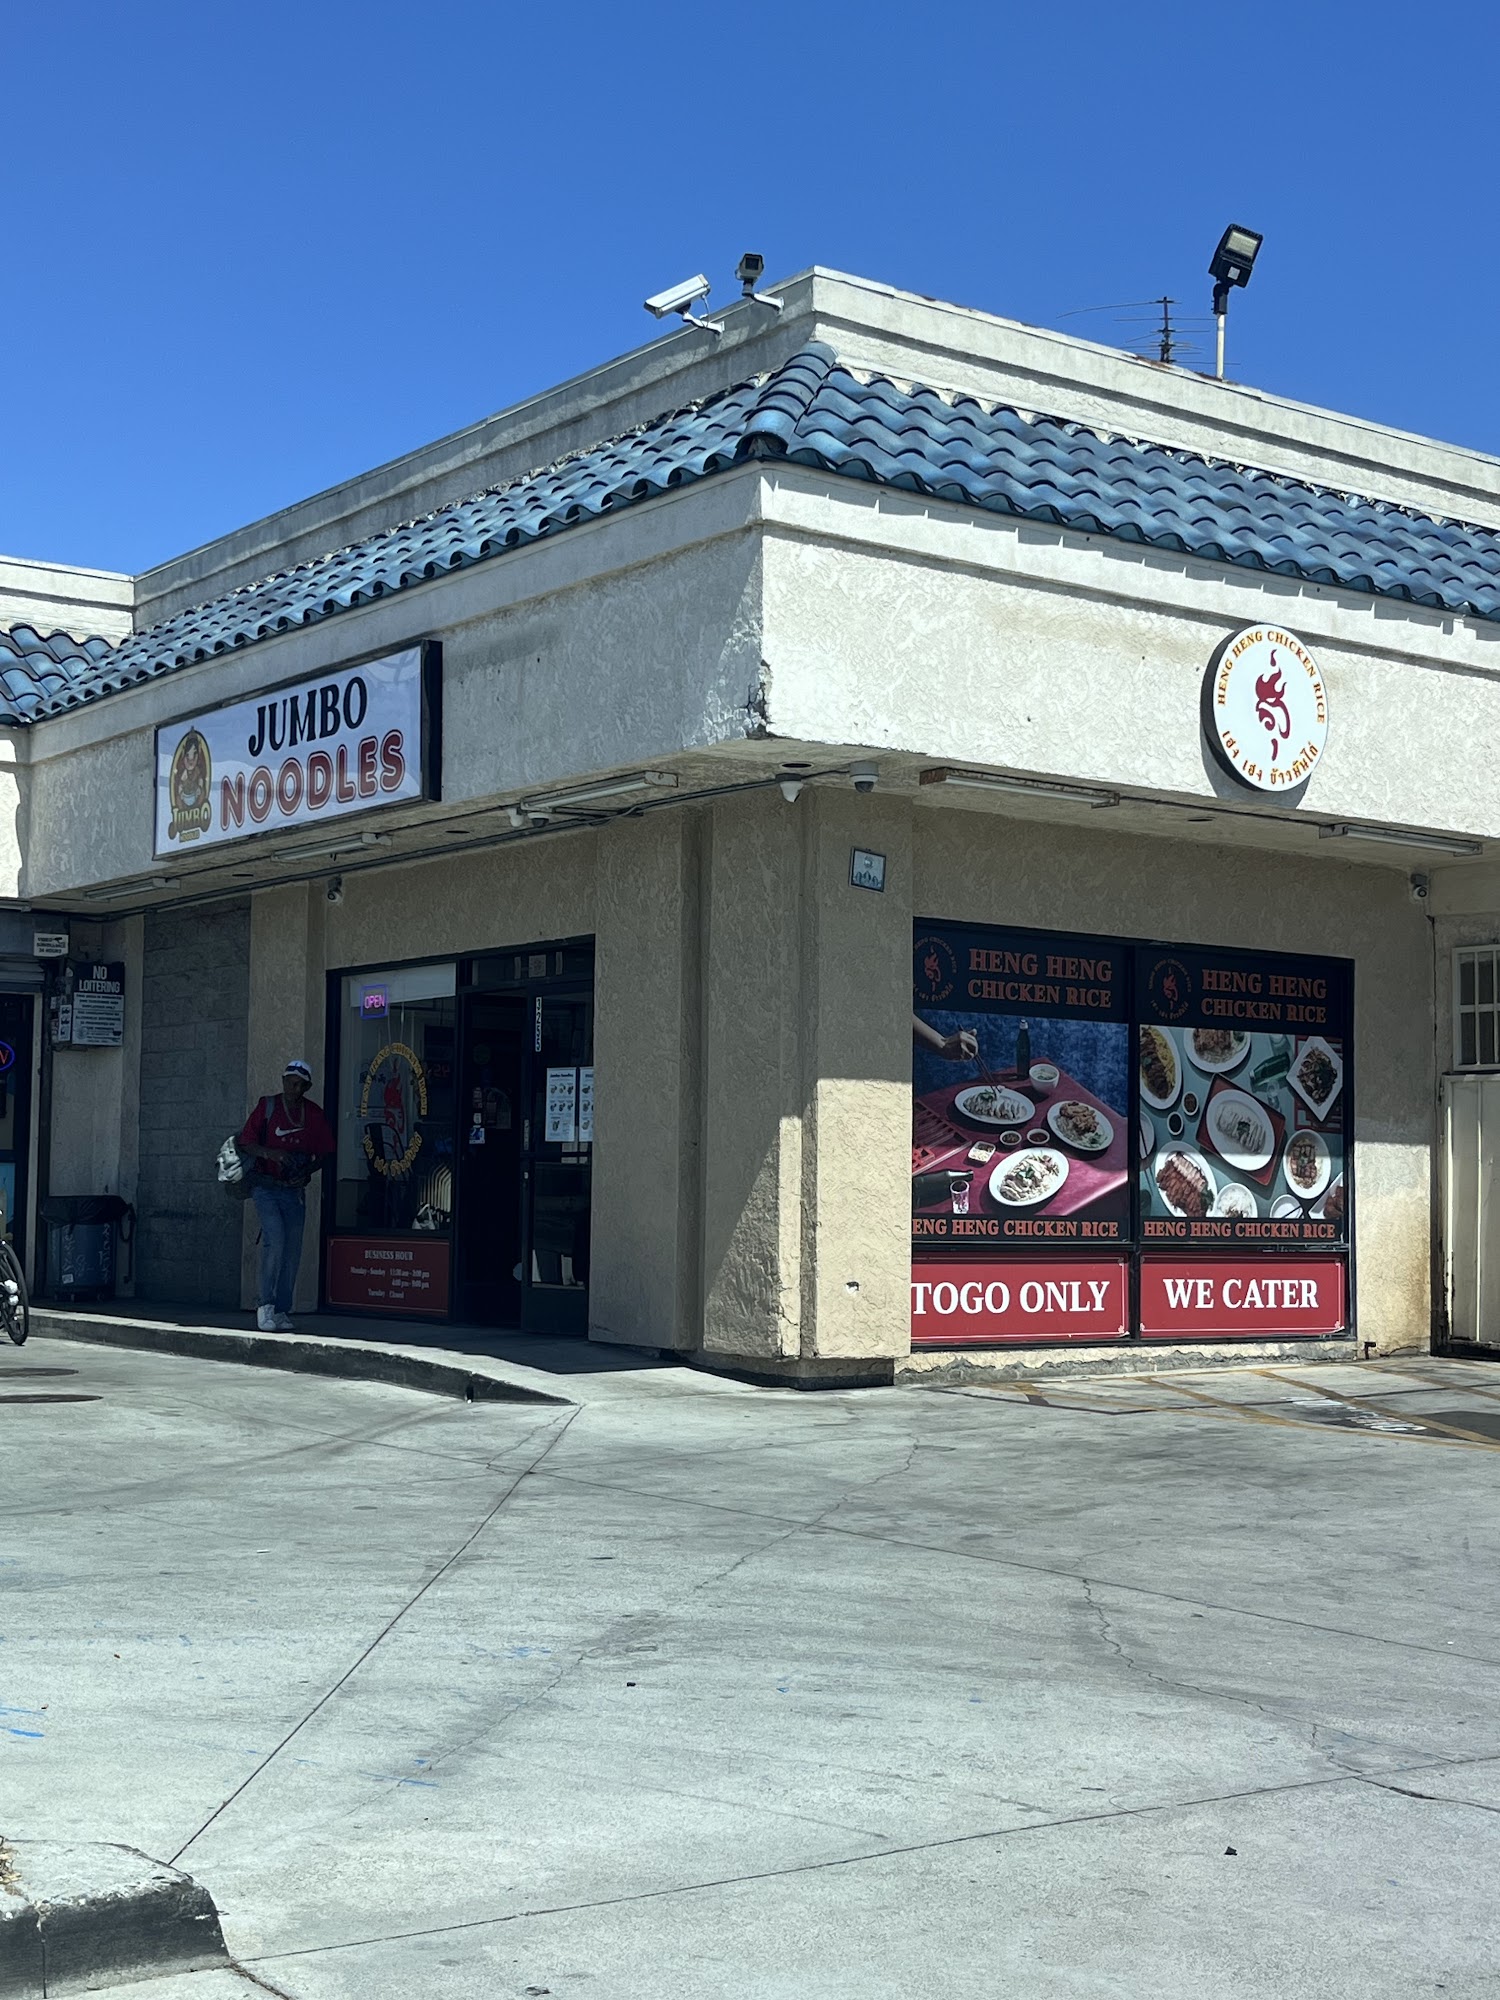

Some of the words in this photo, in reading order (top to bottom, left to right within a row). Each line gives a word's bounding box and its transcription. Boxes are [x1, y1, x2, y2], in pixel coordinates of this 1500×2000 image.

[1217, 658, 1233, 706] HENG
[1231, 631, 1263, 659] HENG
[1267, 630, 1316, 678] CHICKEN
[1313, 681, 1325, 725] RICE
[248, 677, 368, 757] JUMBO
[220, 729, 406, 831] NOODLES
[169, 801, 211, 840] JUMBO
[93, 965, 108, 980] NO
[968, 948, 1039, 976] HENG
[1046, 955, 1113, 982] HENG
[79, 980, 120, 993] LOITERING
[968, 979, 1061, 1005] CHICKEN
[1065, 986, 1112, 1009] RICE
[1202, 969, 1263, 994] HENG
[1268, 975, 1328, 999] HENG
[364, 995, 385, 1009] OPEN
[1201, 998, 1282, 1021] CHICKEN
[1286, 1004, 1327, 1024] RICE
[912, 1219, 948, 1235] ENG
[951, 1219, 999, 1236] HENG
[1003, 1220, 1077, 1237] CHICKEN
[1081, 1221, 1119, 1237] RICE
[1144, 1221, 1187, 1237] HENG
[1190, 1221, 1231, 1237] HENG
[1235, 1222, 1299, 1238] CHICKEN
[1303, 1223, 1336, 1238] RICE
[364, 1250, 394, 1260] BUSINESS
[395, 1251, 414, 1261] HOUR
[911, 1281, 1011, 1314] TOGO
[1019, 1281, 1110, 1313] ONLY
[1162, 1278, 1215, 1309] WE
[1222, 1278, 1319, 1309] CATER
